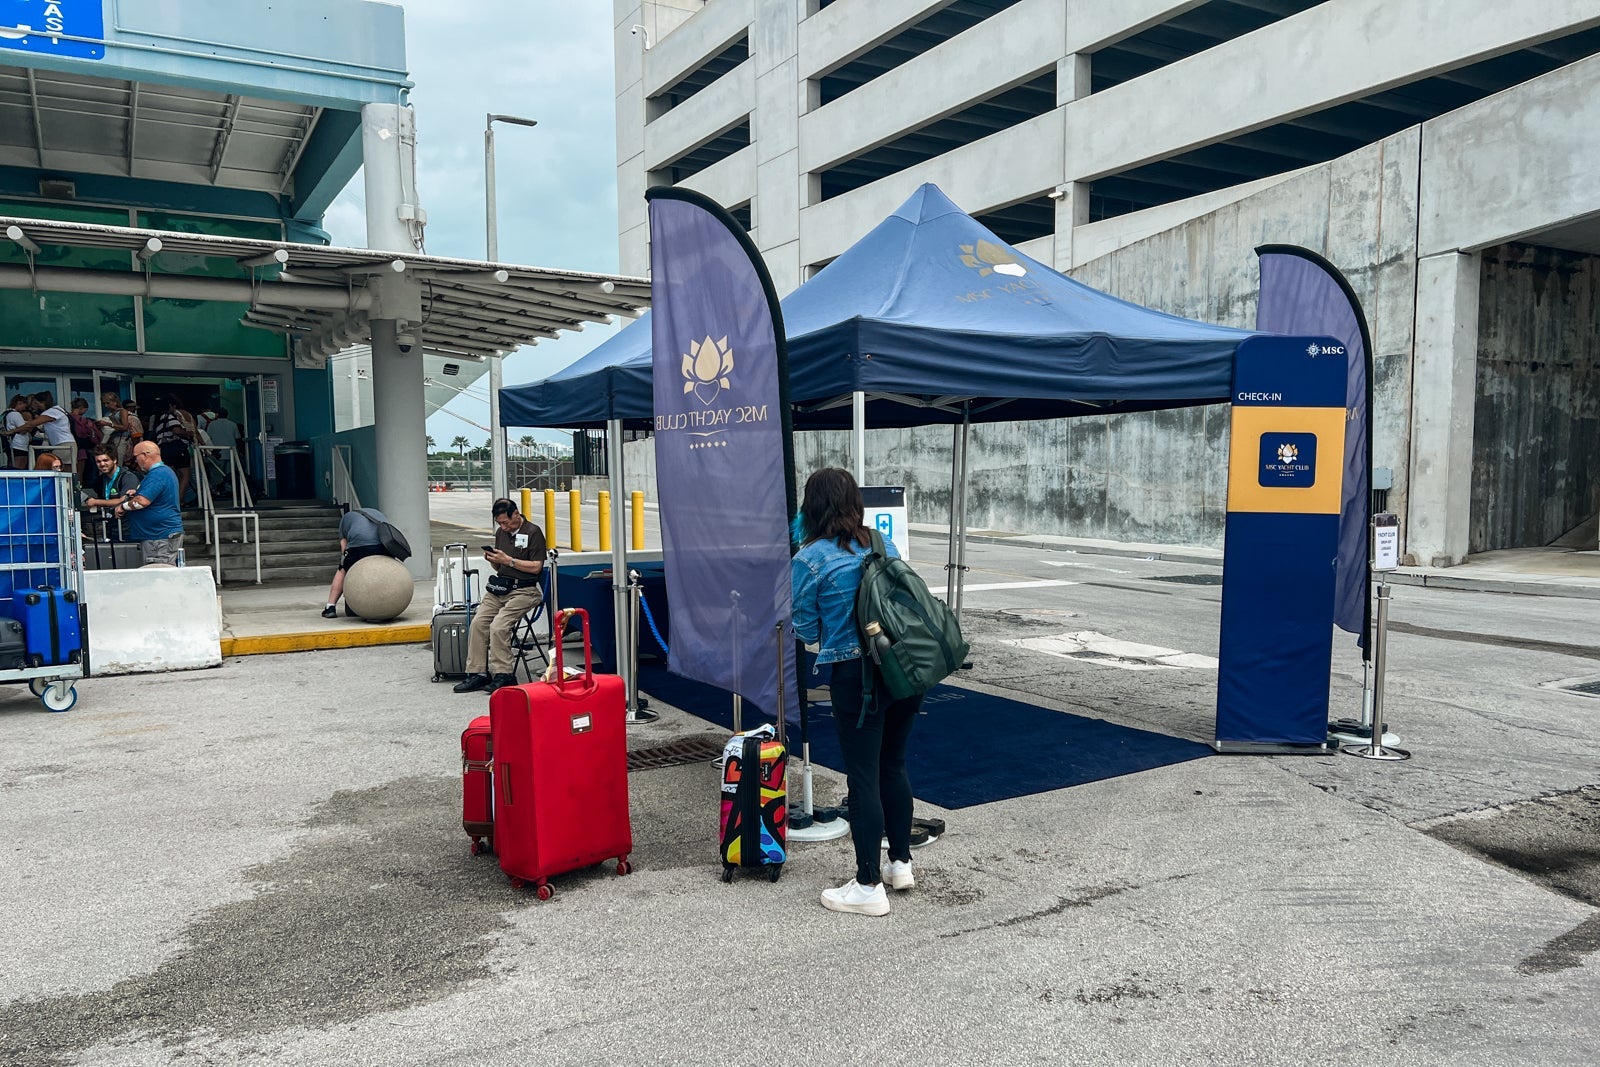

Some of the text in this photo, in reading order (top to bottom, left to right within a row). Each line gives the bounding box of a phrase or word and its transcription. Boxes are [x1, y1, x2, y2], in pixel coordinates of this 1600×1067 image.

[43, 0, 64, 45] AST
[1321, 346, 1345, 355] MSC
[1238, 392, 1282, 401] CHECK-IN
